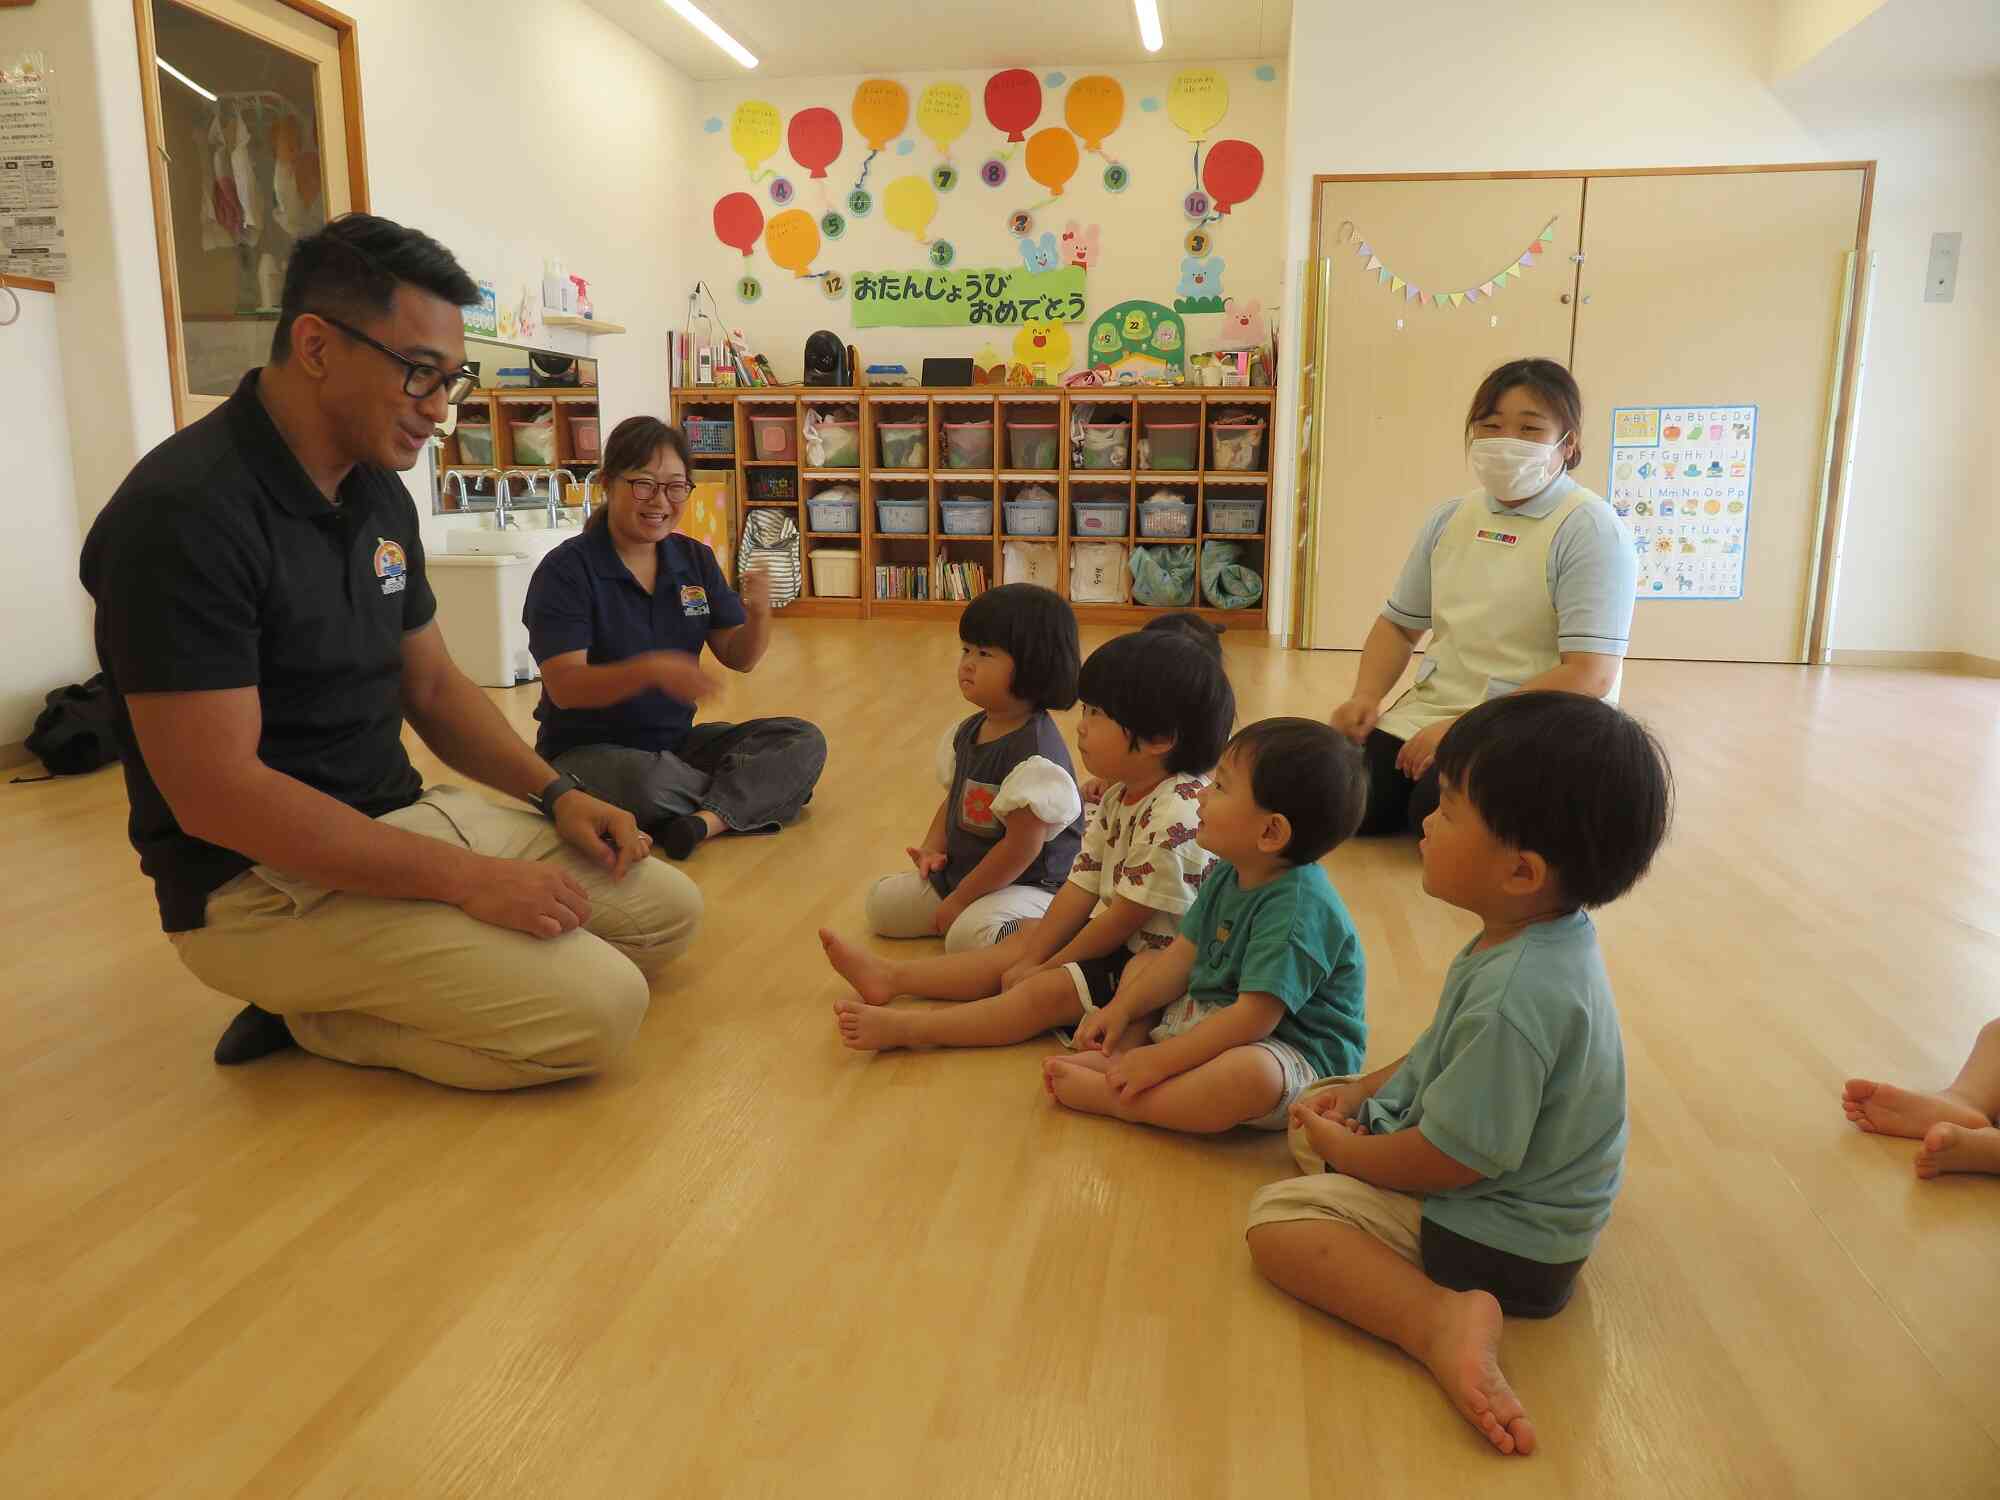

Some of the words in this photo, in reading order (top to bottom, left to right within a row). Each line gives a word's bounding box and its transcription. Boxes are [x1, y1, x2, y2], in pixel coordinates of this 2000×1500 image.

[938, 170, 951, 187] 7
[988, 165, 1000, 182] 8
[1110, 169, 1122, 185] 9
[775, 183, 787, 199] 4
[854, 193, 865, 208] 6
[1190, 197, 1205, 213] 10
[828, 216, 839, 232] 5
[1014, 214, 1028, 232] 2
[1191, 235, 1205, 251] 3
[743, 281, 756, 297] 11
[825, 276, 843, 294] 12
[854, 272, 1012, 303] おたんじょうび
[968, 292, 1086, 324] おめでとう
